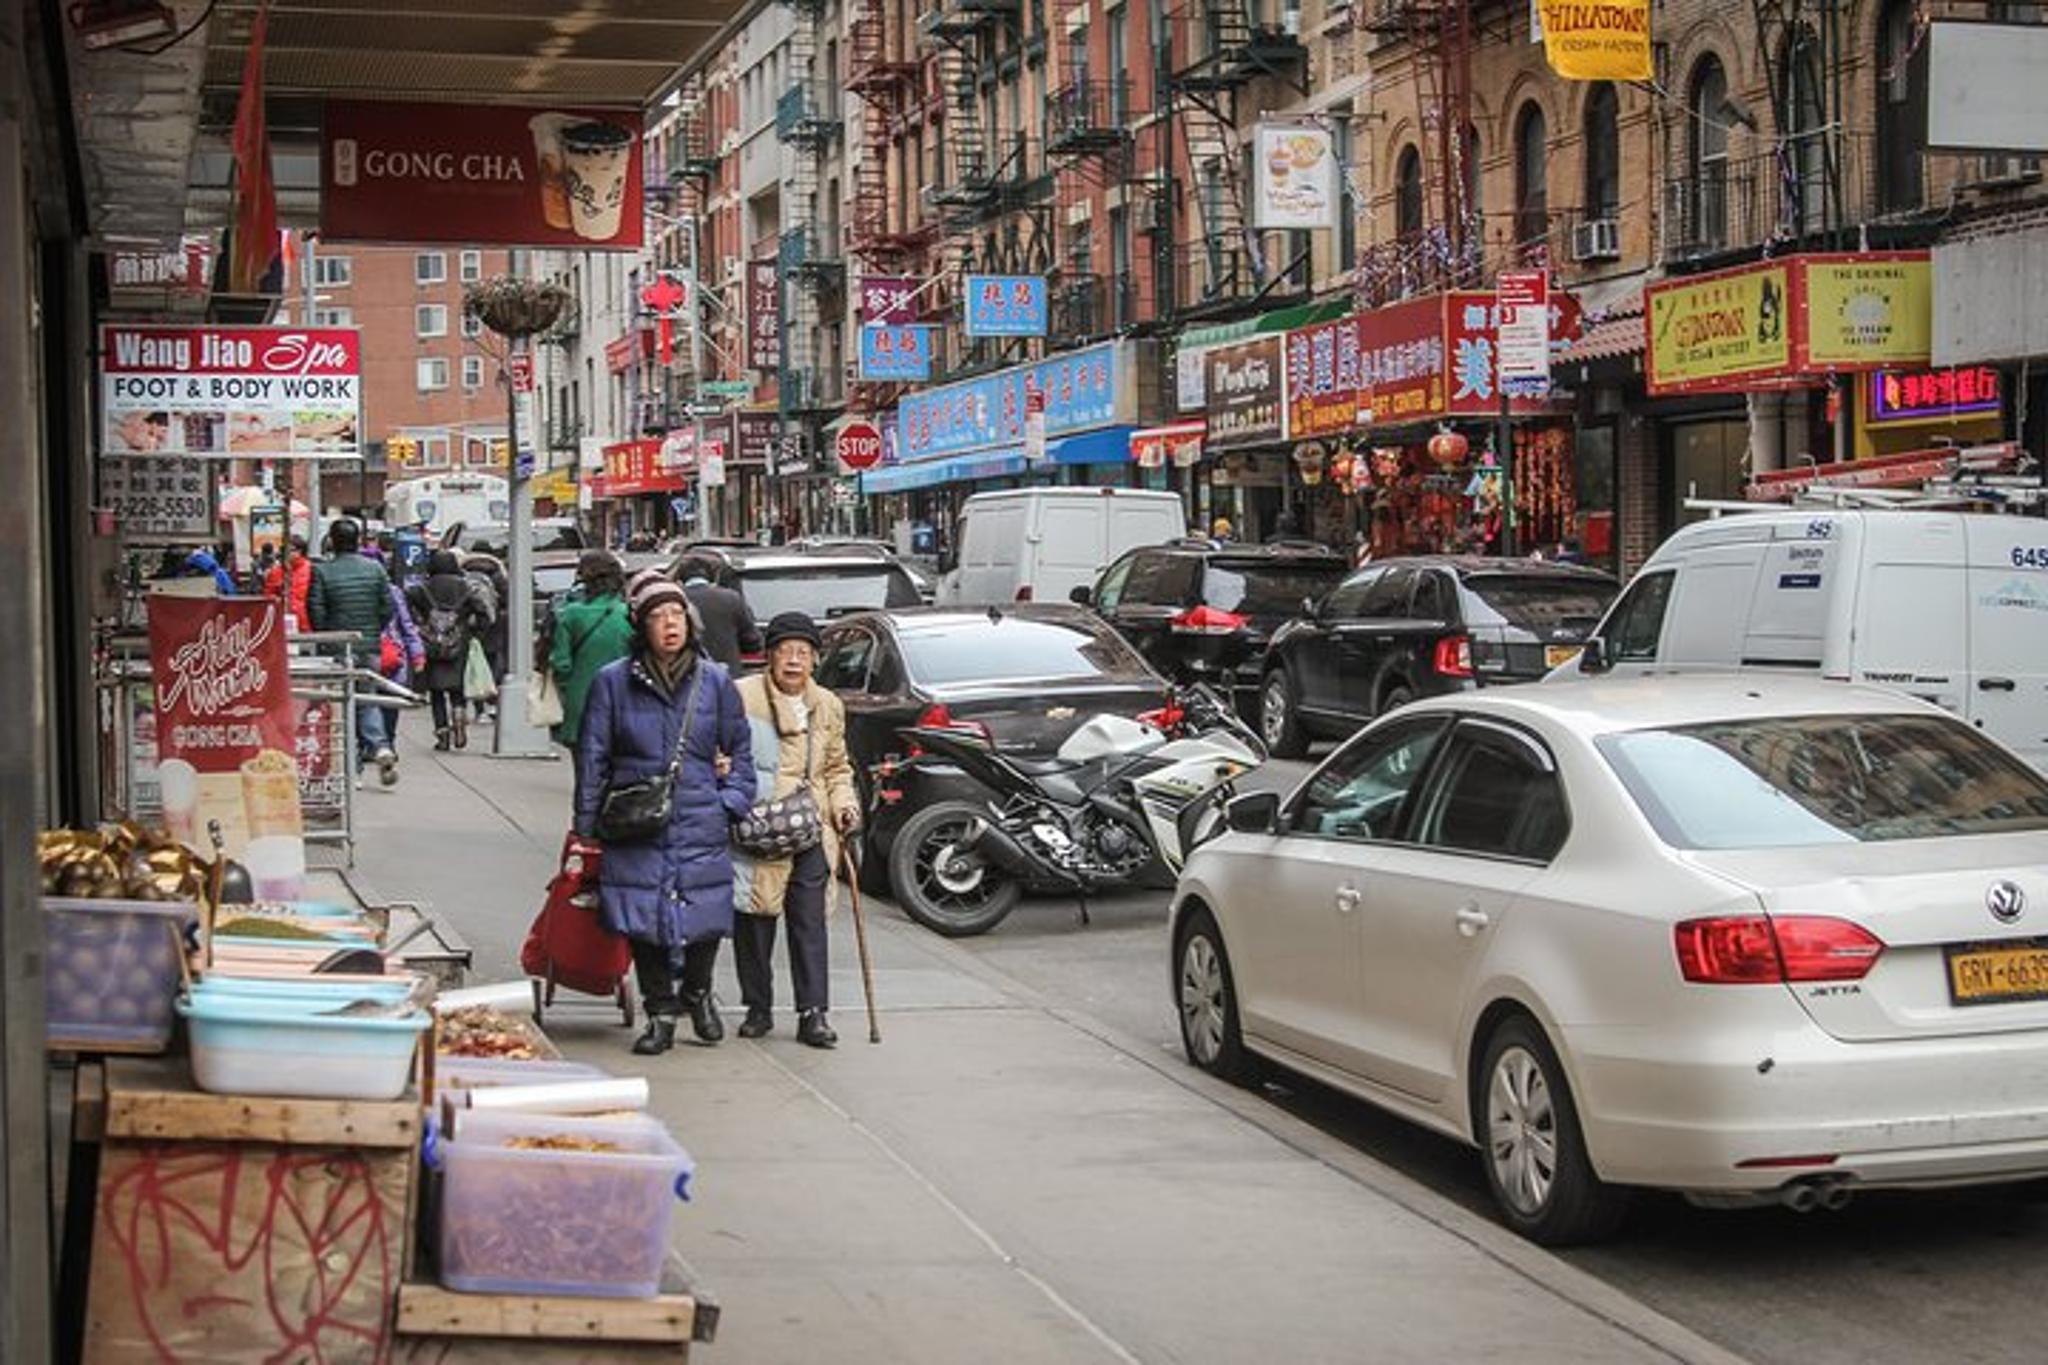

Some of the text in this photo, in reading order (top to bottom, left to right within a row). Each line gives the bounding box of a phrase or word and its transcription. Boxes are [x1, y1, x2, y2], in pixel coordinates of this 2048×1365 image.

[364, 150, 454, 179] GONG
[462, 154, 525, 181] CHA
[115, 334, 348, 375] Wang Jiao Spa
[116, 379, 352, 399] FOOT & BODY WORK
[840, 438, 879, 456] STOP
[1809, 984, 1862, 997] JETTA
